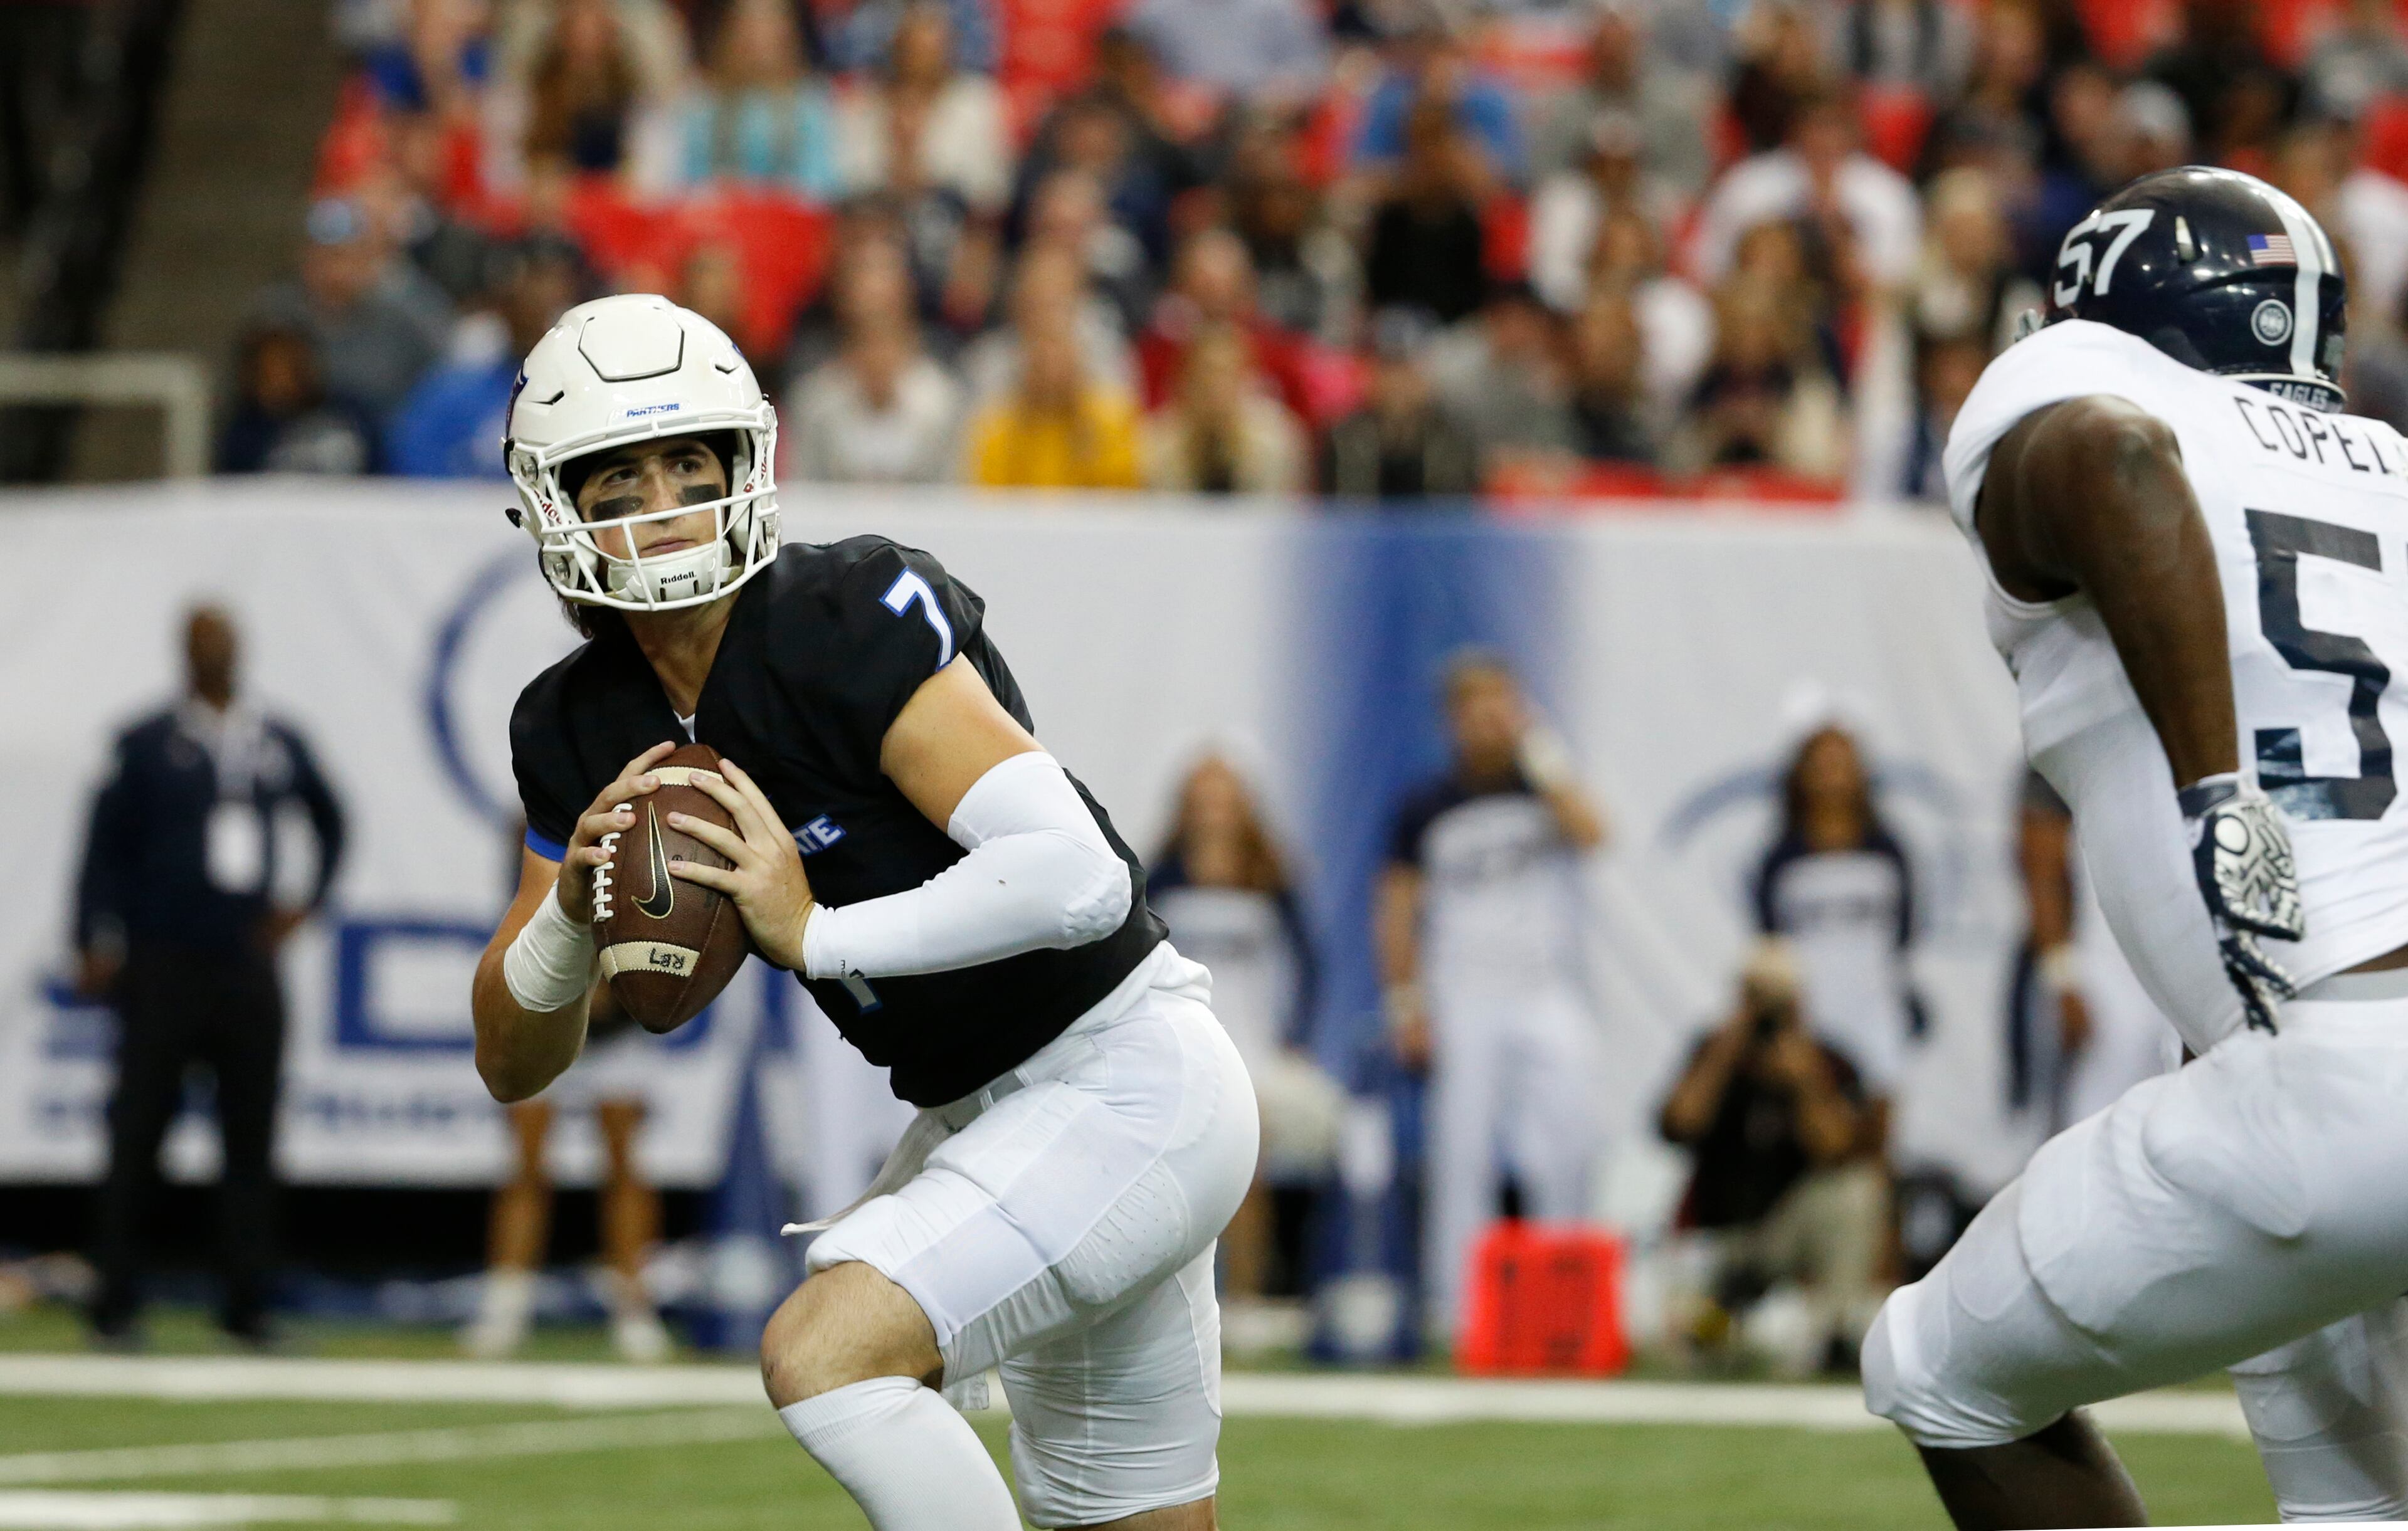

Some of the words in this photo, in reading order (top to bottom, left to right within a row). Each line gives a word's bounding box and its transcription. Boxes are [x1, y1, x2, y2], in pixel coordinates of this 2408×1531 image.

[2054, 208, 2156, 308] 57
[626, 403, 680, 418] PANTHERS
[2269, 382, 2330, 405] EAGLES
[660, 571, 695, 585] Riddell
[879, 566, 954, 671] 7
[2244, 508, 2408, 820] 5
